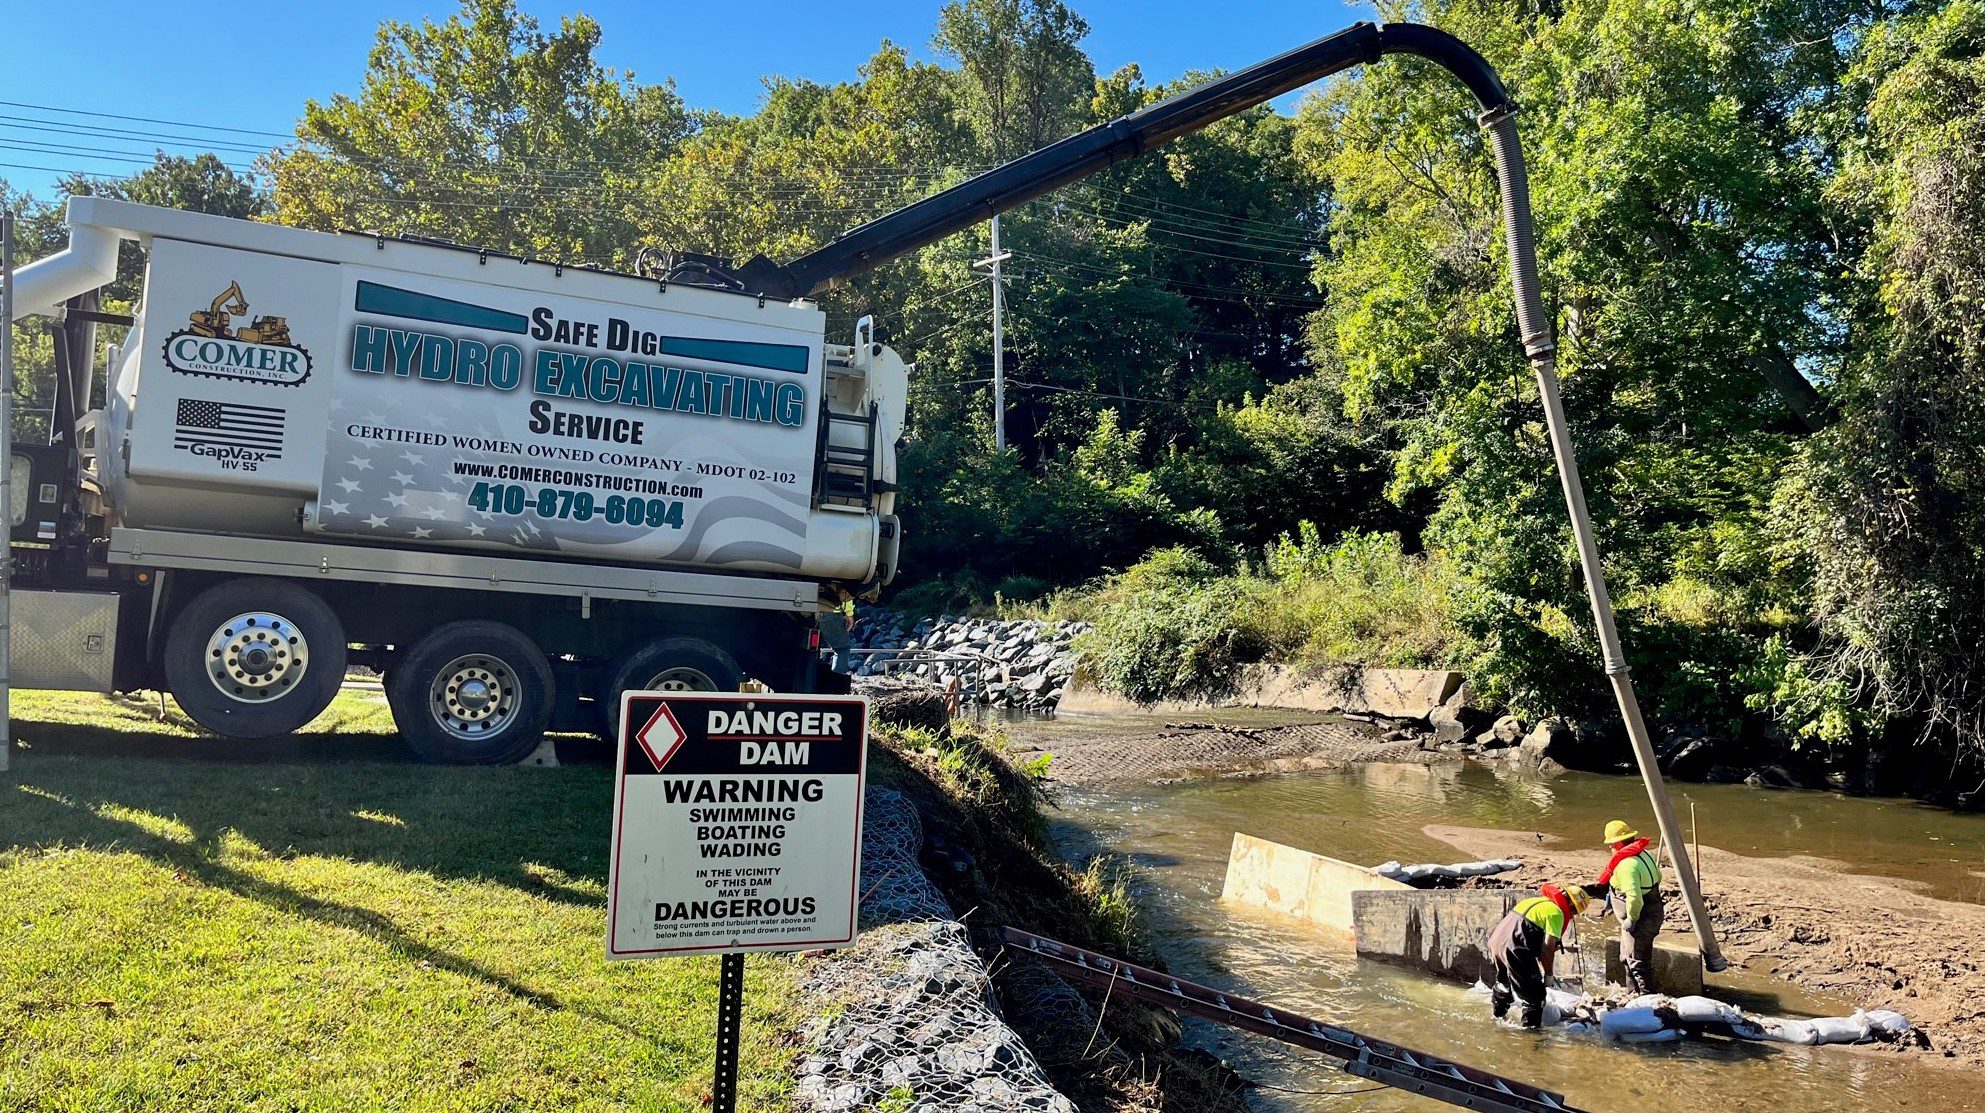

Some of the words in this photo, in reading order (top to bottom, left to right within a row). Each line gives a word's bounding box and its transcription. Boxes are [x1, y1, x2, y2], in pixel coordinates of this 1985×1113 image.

[531, 307, 598, 348] SAFE
[606, 318, 658, 356] DIG
[175, 338, 300, 374] COMER
[267, 372, 287, 380] INC.
[351, 325, 522, 391] HYDRO
[533, 349, 804, 427] EXCAVATING
[529, 400, 644, 445] SERVICE
[190, 443, 266, 462] GapVax
[346, 424, 448, 446] CERTIFIED
[452, 436, 523, 455] WOMEN
[527, 444, 594, 462] OWNED
[598, 452, 683, 473] COMPANY
[696, 463, 746, 479] MDOT
[749, 469, 796, 484] 02-102
[467, 481, 684, 530] 410-879-6094
[707, 710, 843, 736] DANGER
[739, 741, 810, 765] DAM
[663, 779, 824, 803] WARNING
[689, 807, 796, 823] SWIMMING
[696, 825, 786, 841] BOATING
[700, 842, 782, 858] WADING
[696, 870, 708, 878] IN
[711, 869, 732, 877] THE
[735, 867, 781, 876] VICINITY
[705, 880, 719, 888] OF
[722, 879, 747, 887] THIS
[749, 878, 772, 886] DAM
[718, 889, 741, 897] MAY
[744, 888, 758, 897] BE
[654, 897, 816, 921] DANGEROUS
[653, 923, 678, 931] Strong
[726, 918, 759, 926] turbulent
[742, 927, 756, 935] and
[757, 926, 779, 934] drown
[786, 925, 812, 934] person.
